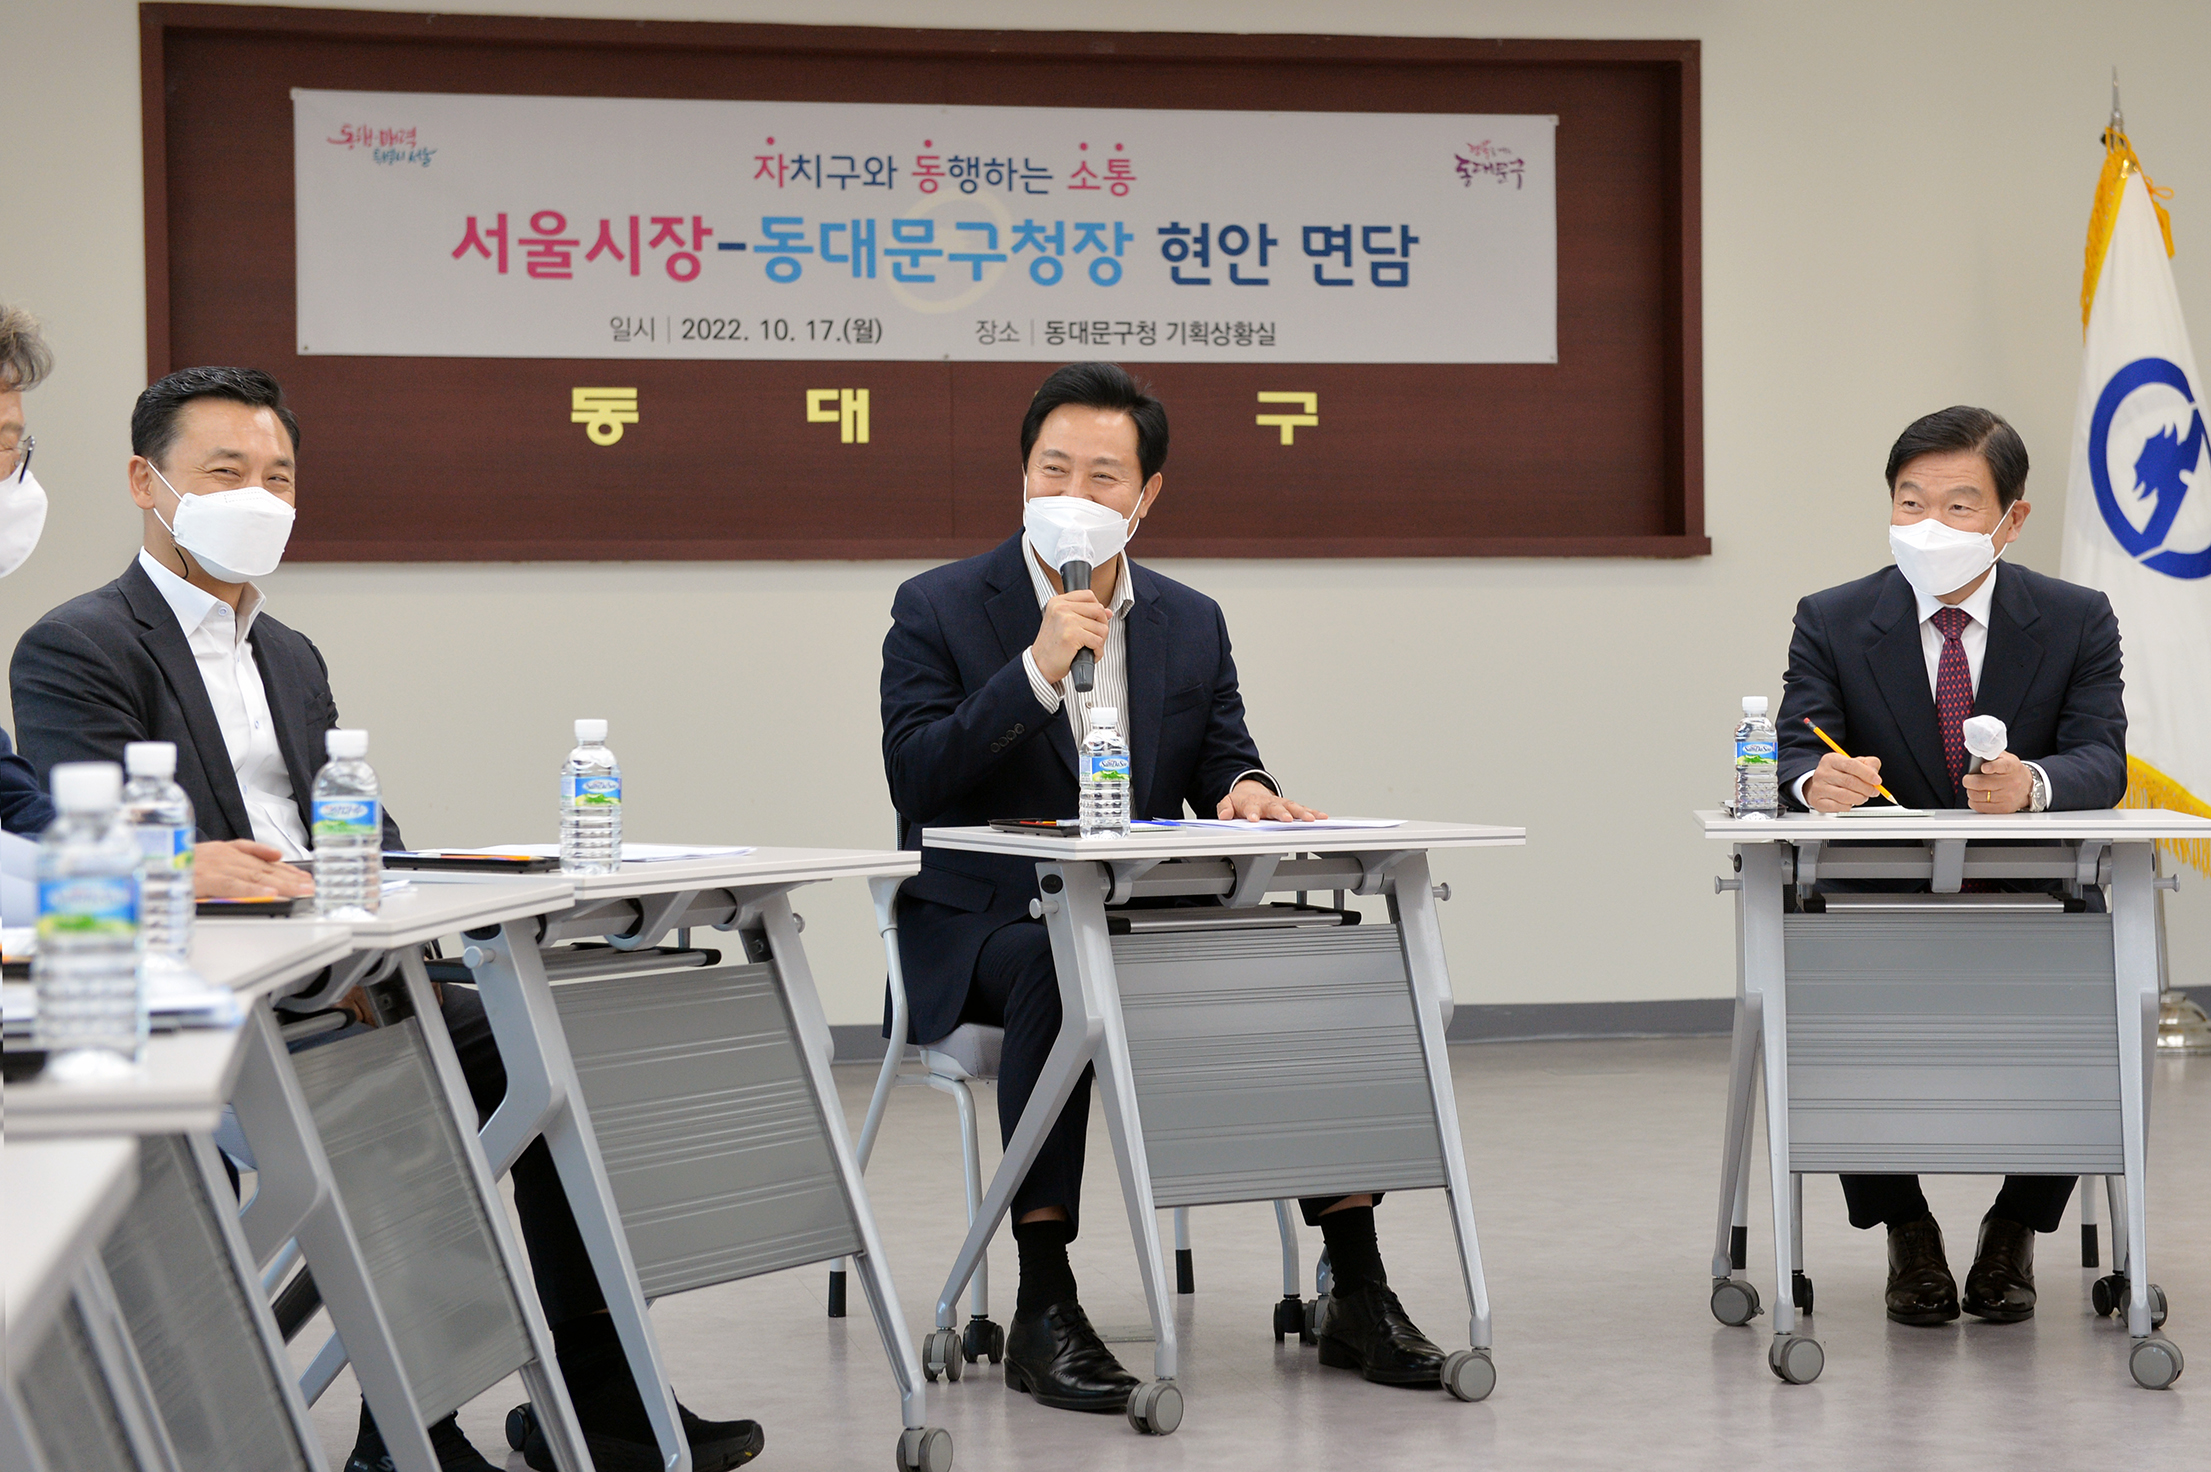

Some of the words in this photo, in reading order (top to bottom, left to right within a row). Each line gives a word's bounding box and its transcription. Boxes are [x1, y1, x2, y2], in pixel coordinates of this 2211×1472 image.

[754, 153, 899, 191] 자치구와
[912, 155, 1055, 195] 동행하는
[1067, 158, 1138, 197] 소통
[1454, 153, 1526, 190] 동대문구
[1157, 222, 1279, 288] 현안
[1302, 223, 1421, 289] 면담
[610, 316, 656, 343] 일시
[681, 318, 749, 342] 2022.
[760, 319, 796, 342] 10.
[806, 319, 883, 345] 17.(월)
[975, 320, 1021, 346] 장소
[1044, 321, 1157, 347] 동대문구청
[1165, 321, 1277, 348] 기획상황실
